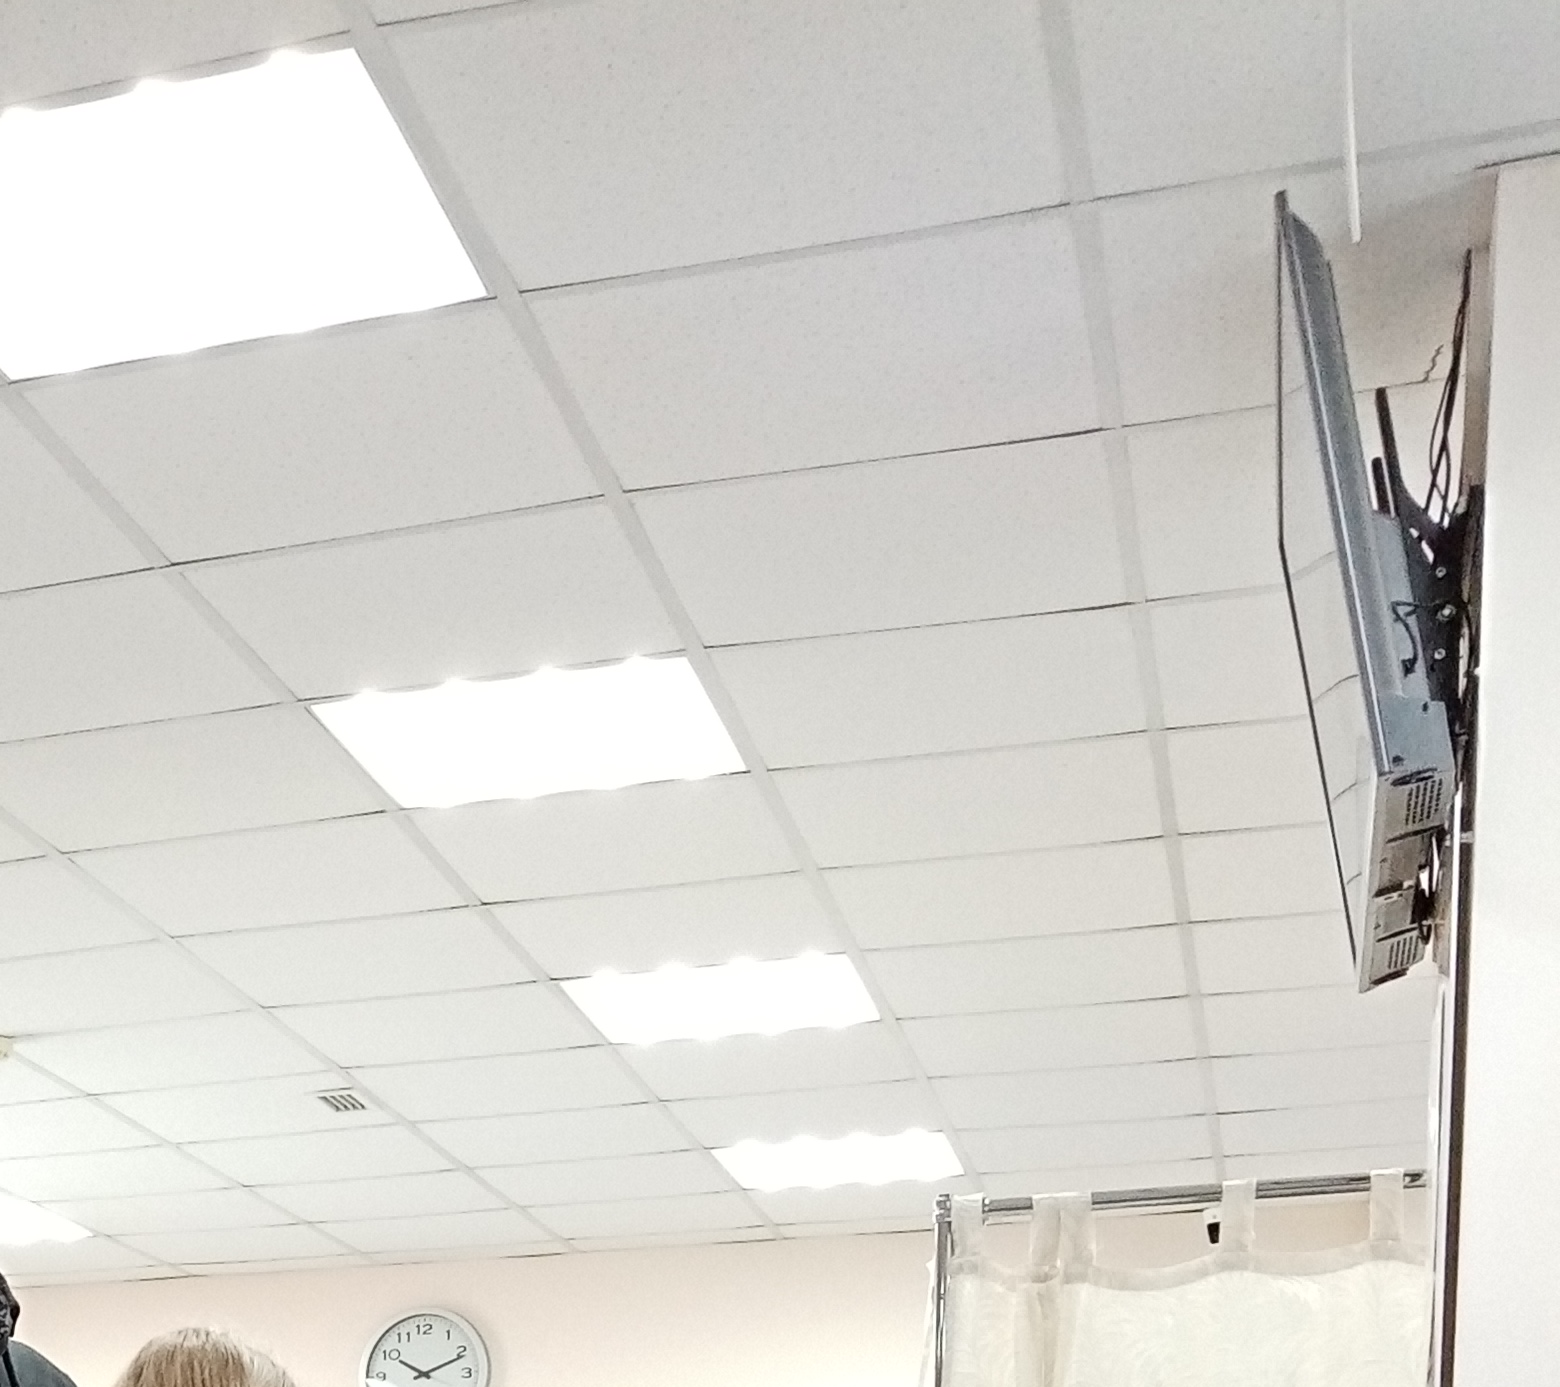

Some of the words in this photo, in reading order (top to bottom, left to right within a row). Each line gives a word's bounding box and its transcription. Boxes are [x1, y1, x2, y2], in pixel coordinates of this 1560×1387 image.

[415, 1323, 433, 1335] 12
[445, 1329, 451, 1341] 1
[397, 1331, 411, 1343] 11
[382, 1348, 401, 1361] 10
[456, 1345, 467, 1357] 2
[375, 1371, 387, 1381] 9
[461, 1367, 472, 1379] 3
